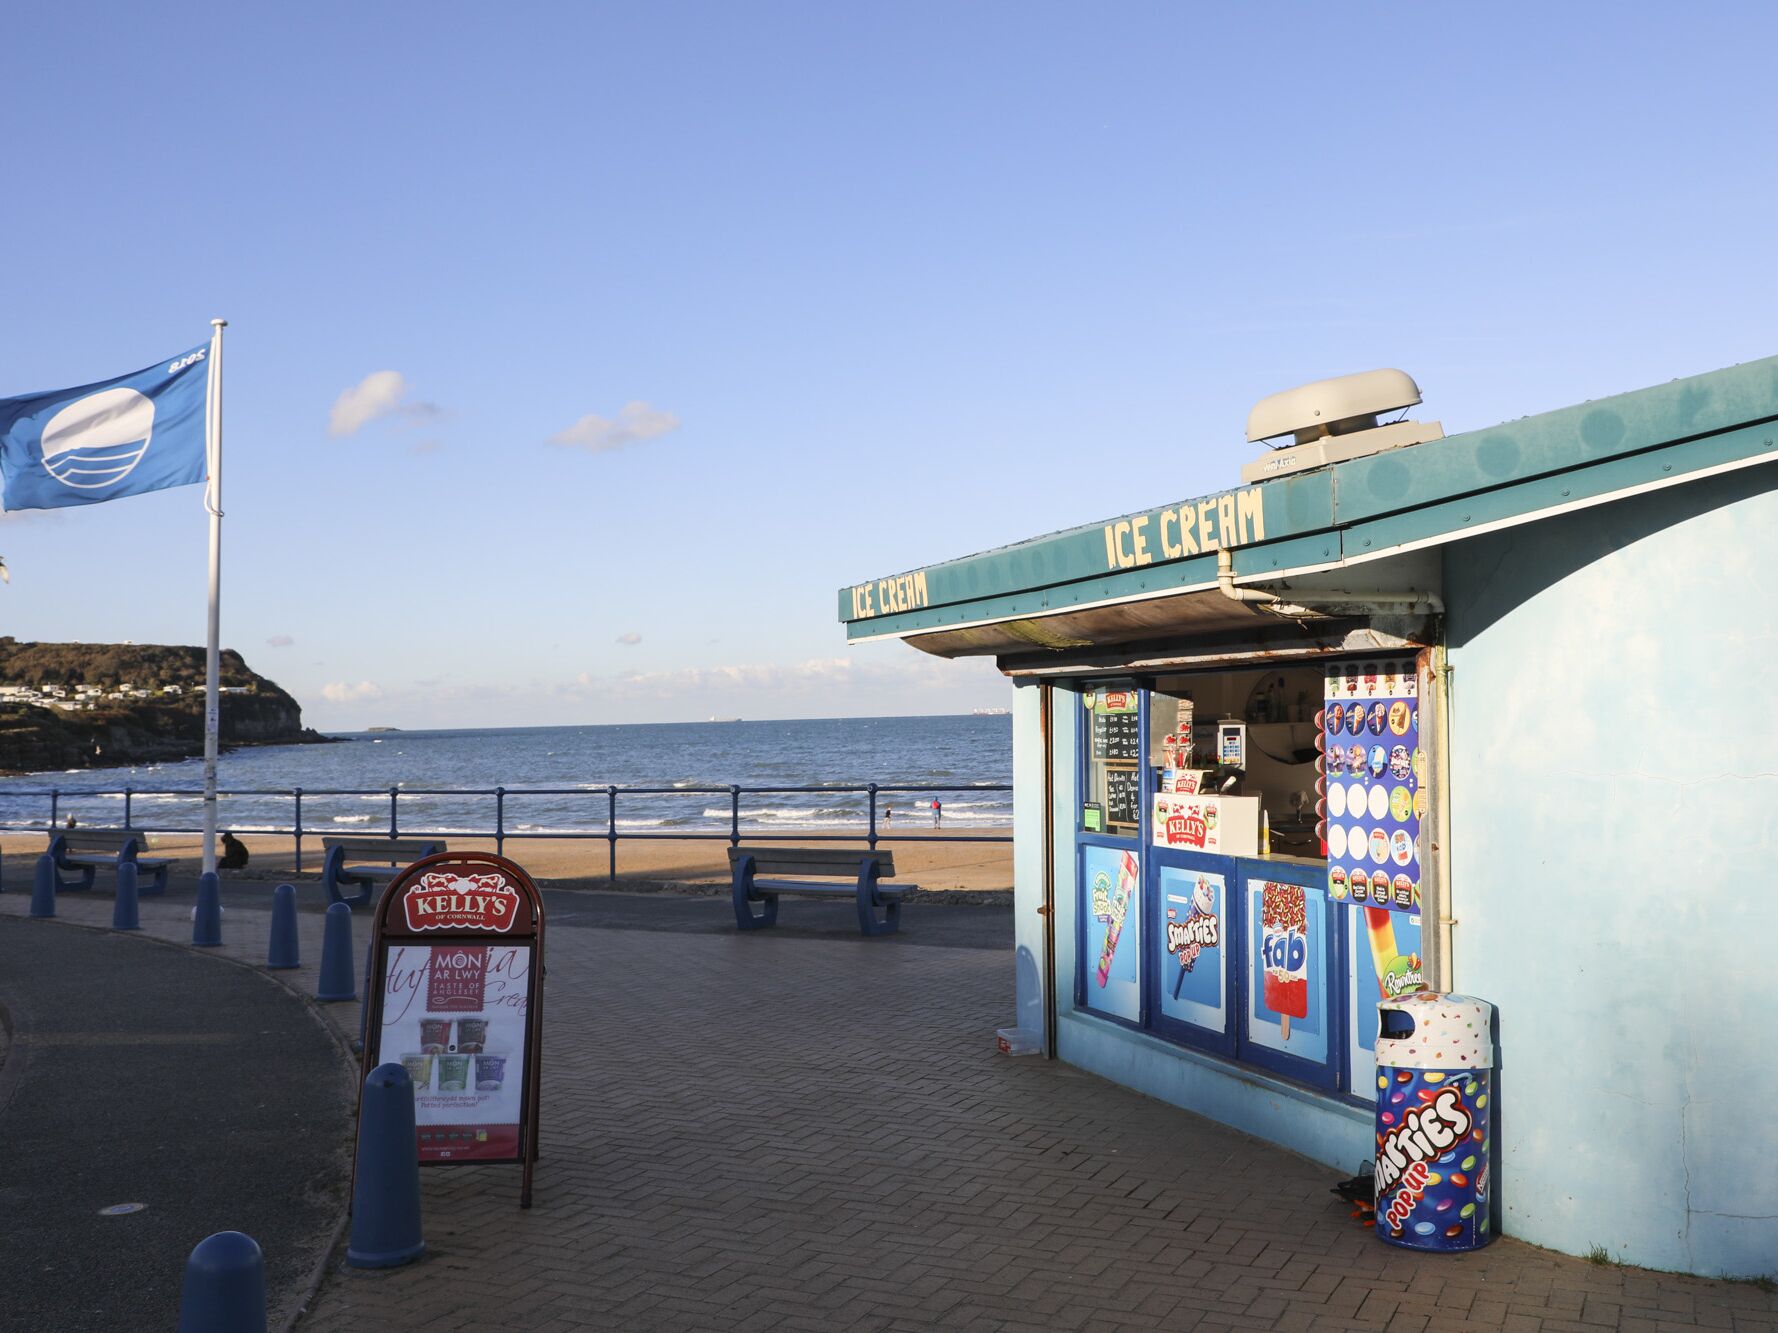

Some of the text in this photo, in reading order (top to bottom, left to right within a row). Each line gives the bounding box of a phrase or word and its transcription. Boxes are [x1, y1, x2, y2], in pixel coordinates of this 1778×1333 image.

[1104, 487, 1264, 570] ICE CREAM
[852, 571, 928, 619] ICE CREAM
[1169, 819, 1204, 837] KELLY'S
[416, 894, 507, 916] KELLY'S
[435, 950, 482, 969] MÔN
[1263, 928, 1306, 972] fab
[434, 970, 480, 980] AR LWY
[1374, 1093, 1468, 1198] MARTIES
[1387, 1162, 1430, 1228] POP UP
